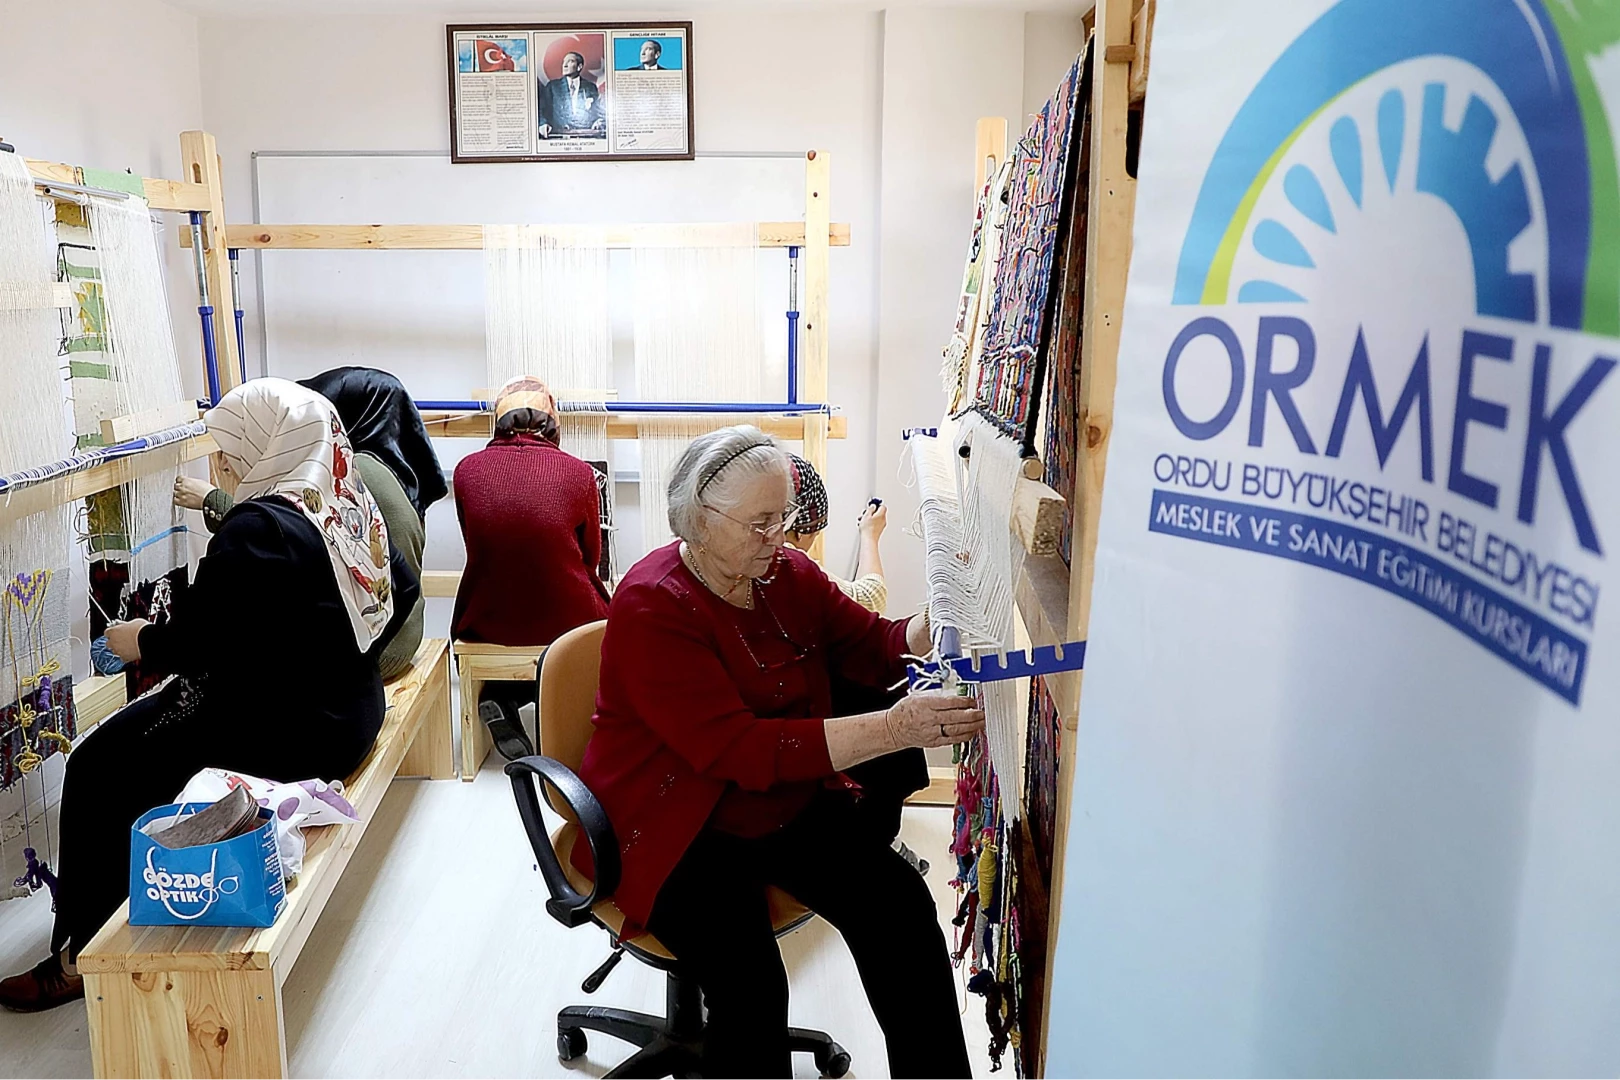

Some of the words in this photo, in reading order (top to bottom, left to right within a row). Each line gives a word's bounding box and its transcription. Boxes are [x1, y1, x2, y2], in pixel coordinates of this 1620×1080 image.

[1162, 315, 1619, 560] ORMEK
[1154, 453, 1232, 491] ORDU
[1155, 501, 1242, 539] MESLEK
[1249, 515, 1282, 547] VE
[1288, 523, 1373, 572] SANAT
[1460, 588, 1580, 690] KURSLARI
[143, 867, 214, 889] GÖZDE
[146, 887, 200, 903] OPTİK
